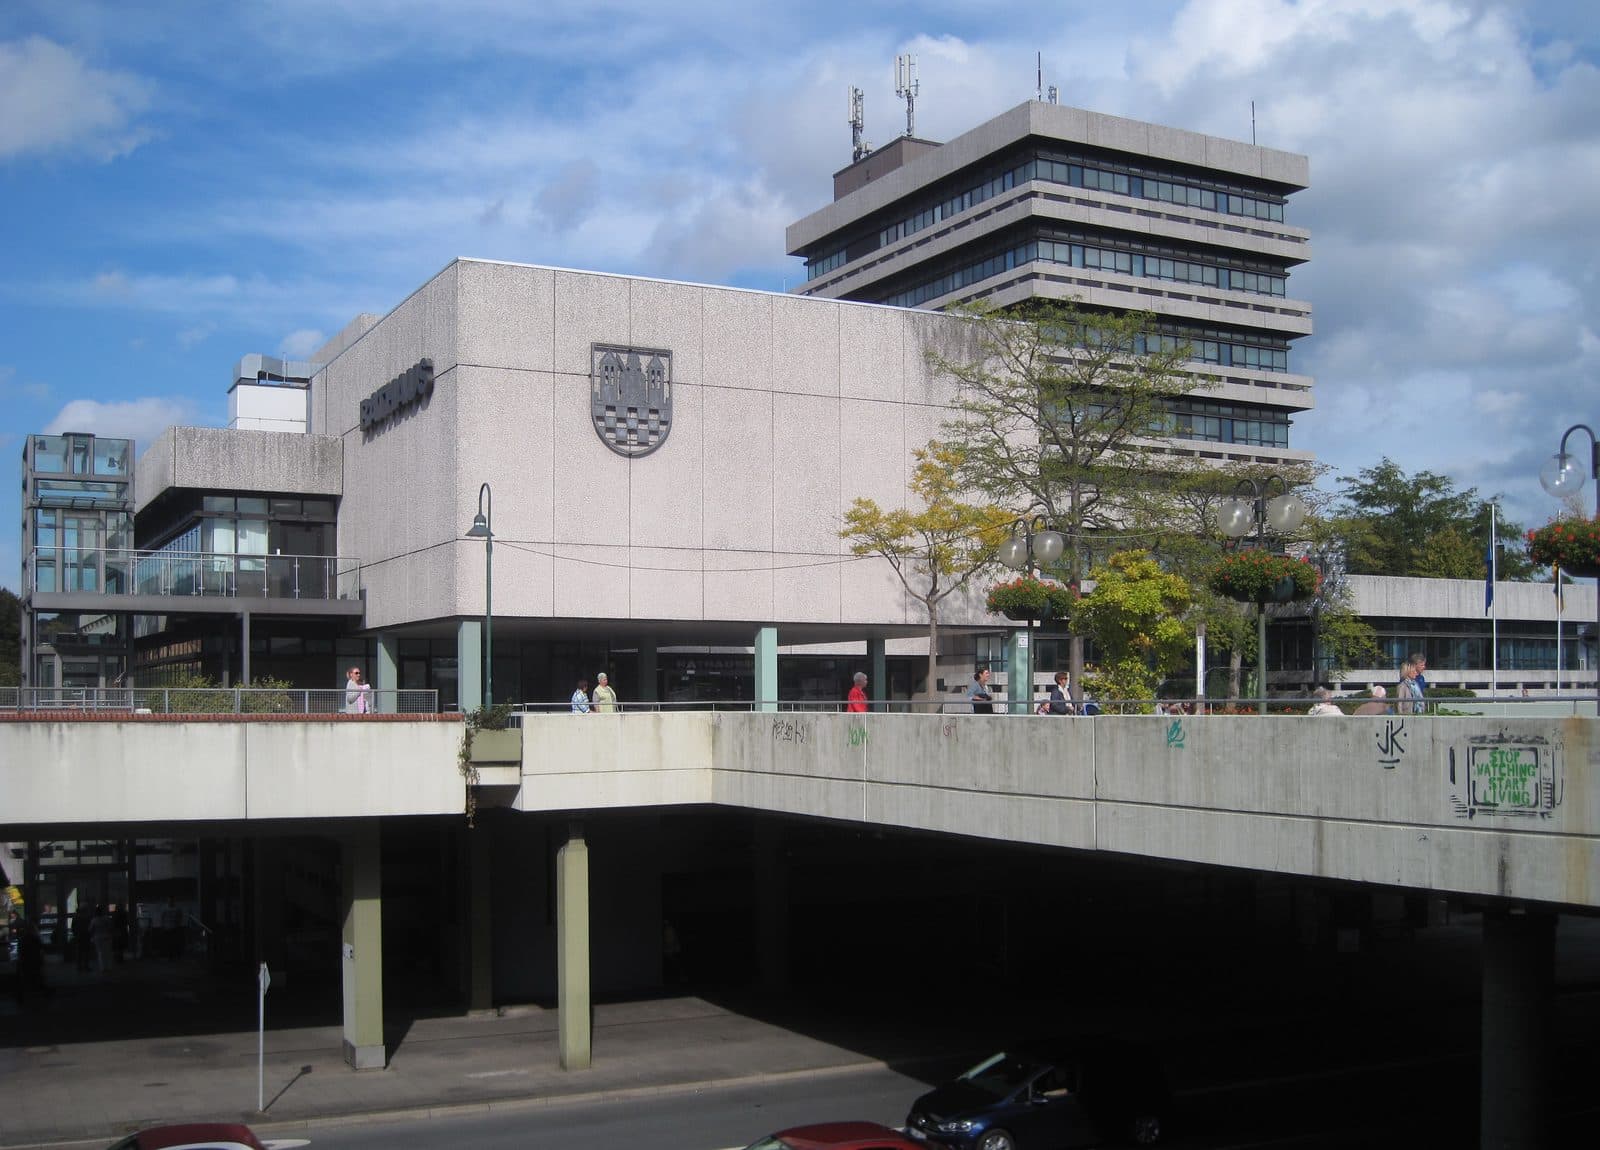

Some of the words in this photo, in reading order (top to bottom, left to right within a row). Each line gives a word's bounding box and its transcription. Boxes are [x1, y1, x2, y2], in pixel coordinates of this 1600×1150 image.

[1489, 750, 1520, 764] STOP
[1488, 777, 1528, 790] START
[1483, 790, 1530, 805] LIVING
